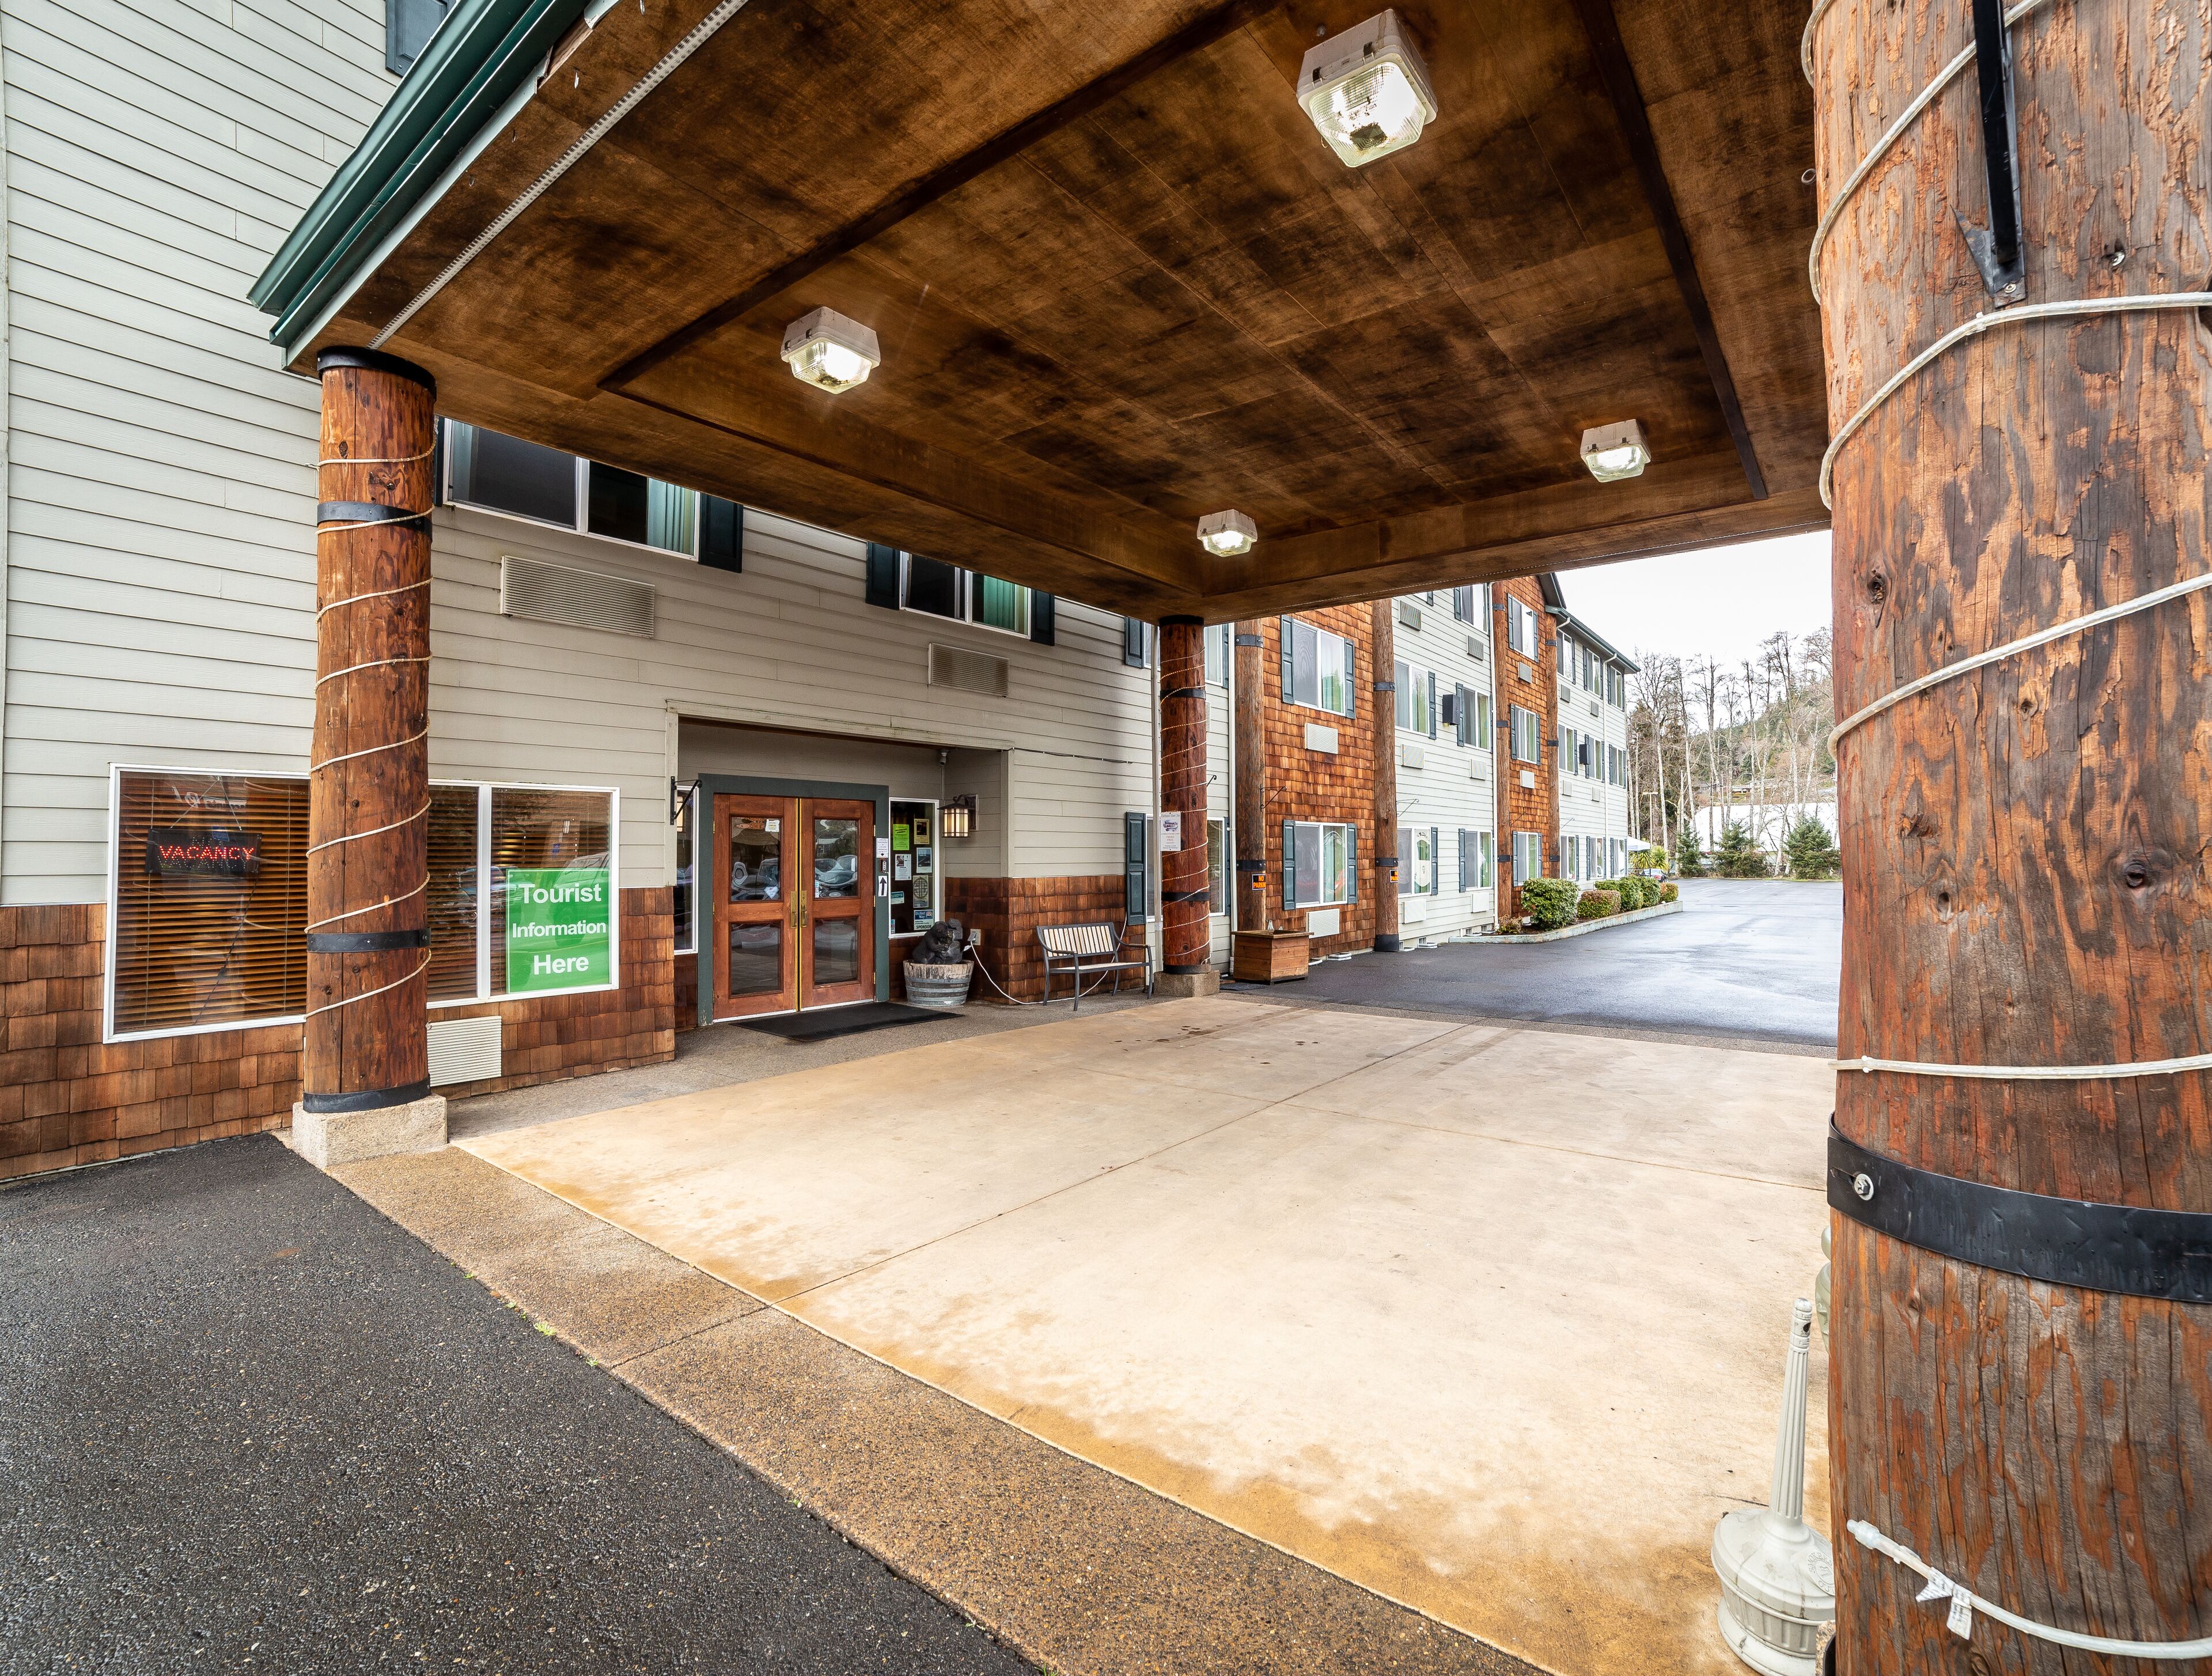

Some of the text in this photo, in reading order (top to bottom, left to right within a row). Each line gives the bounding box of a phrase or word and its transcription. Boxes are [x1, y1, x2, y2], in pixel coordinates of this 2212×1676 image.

[159, 845, 255, 860] VACANCY
[518, 883, 601, 904] Tourist
[513, 920, 606, 938] Information
[534, 955, 589, 975] Here
